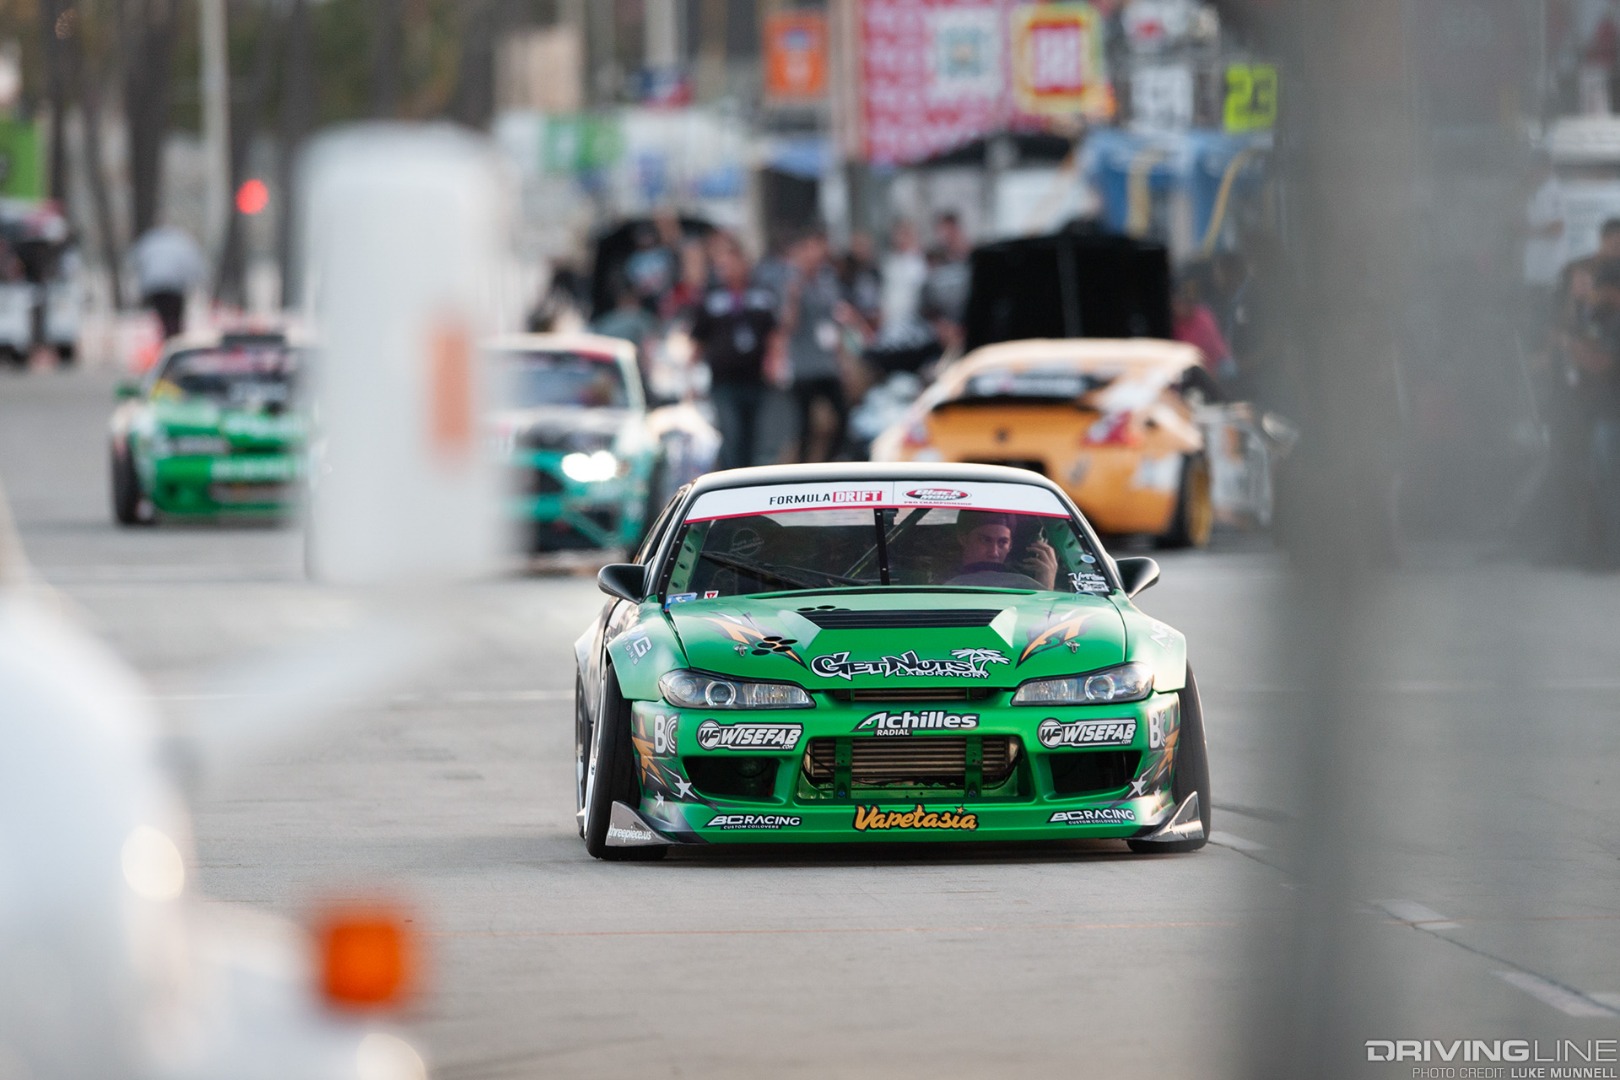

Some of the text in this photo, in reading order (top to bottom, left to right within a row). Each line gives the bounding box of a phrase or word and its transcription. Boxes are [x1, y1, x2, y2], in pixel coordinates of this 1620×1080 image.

[769, 490, 882, 505] FORMULA DRIFT
[896, 670, 990, 678] LABORATORY
[858, 711, 977, 729] Achilles
[721, 728, 802, 745] WISEFAB
[1064, 724, 1137, 743] WISEFAB
[744, 815, 801, 826] RACING
[855, 804, 977, 830] Vapetasia
[1085, 809, 1135, 820] RACING
[608, 822, 652, 843] threepiece.us
